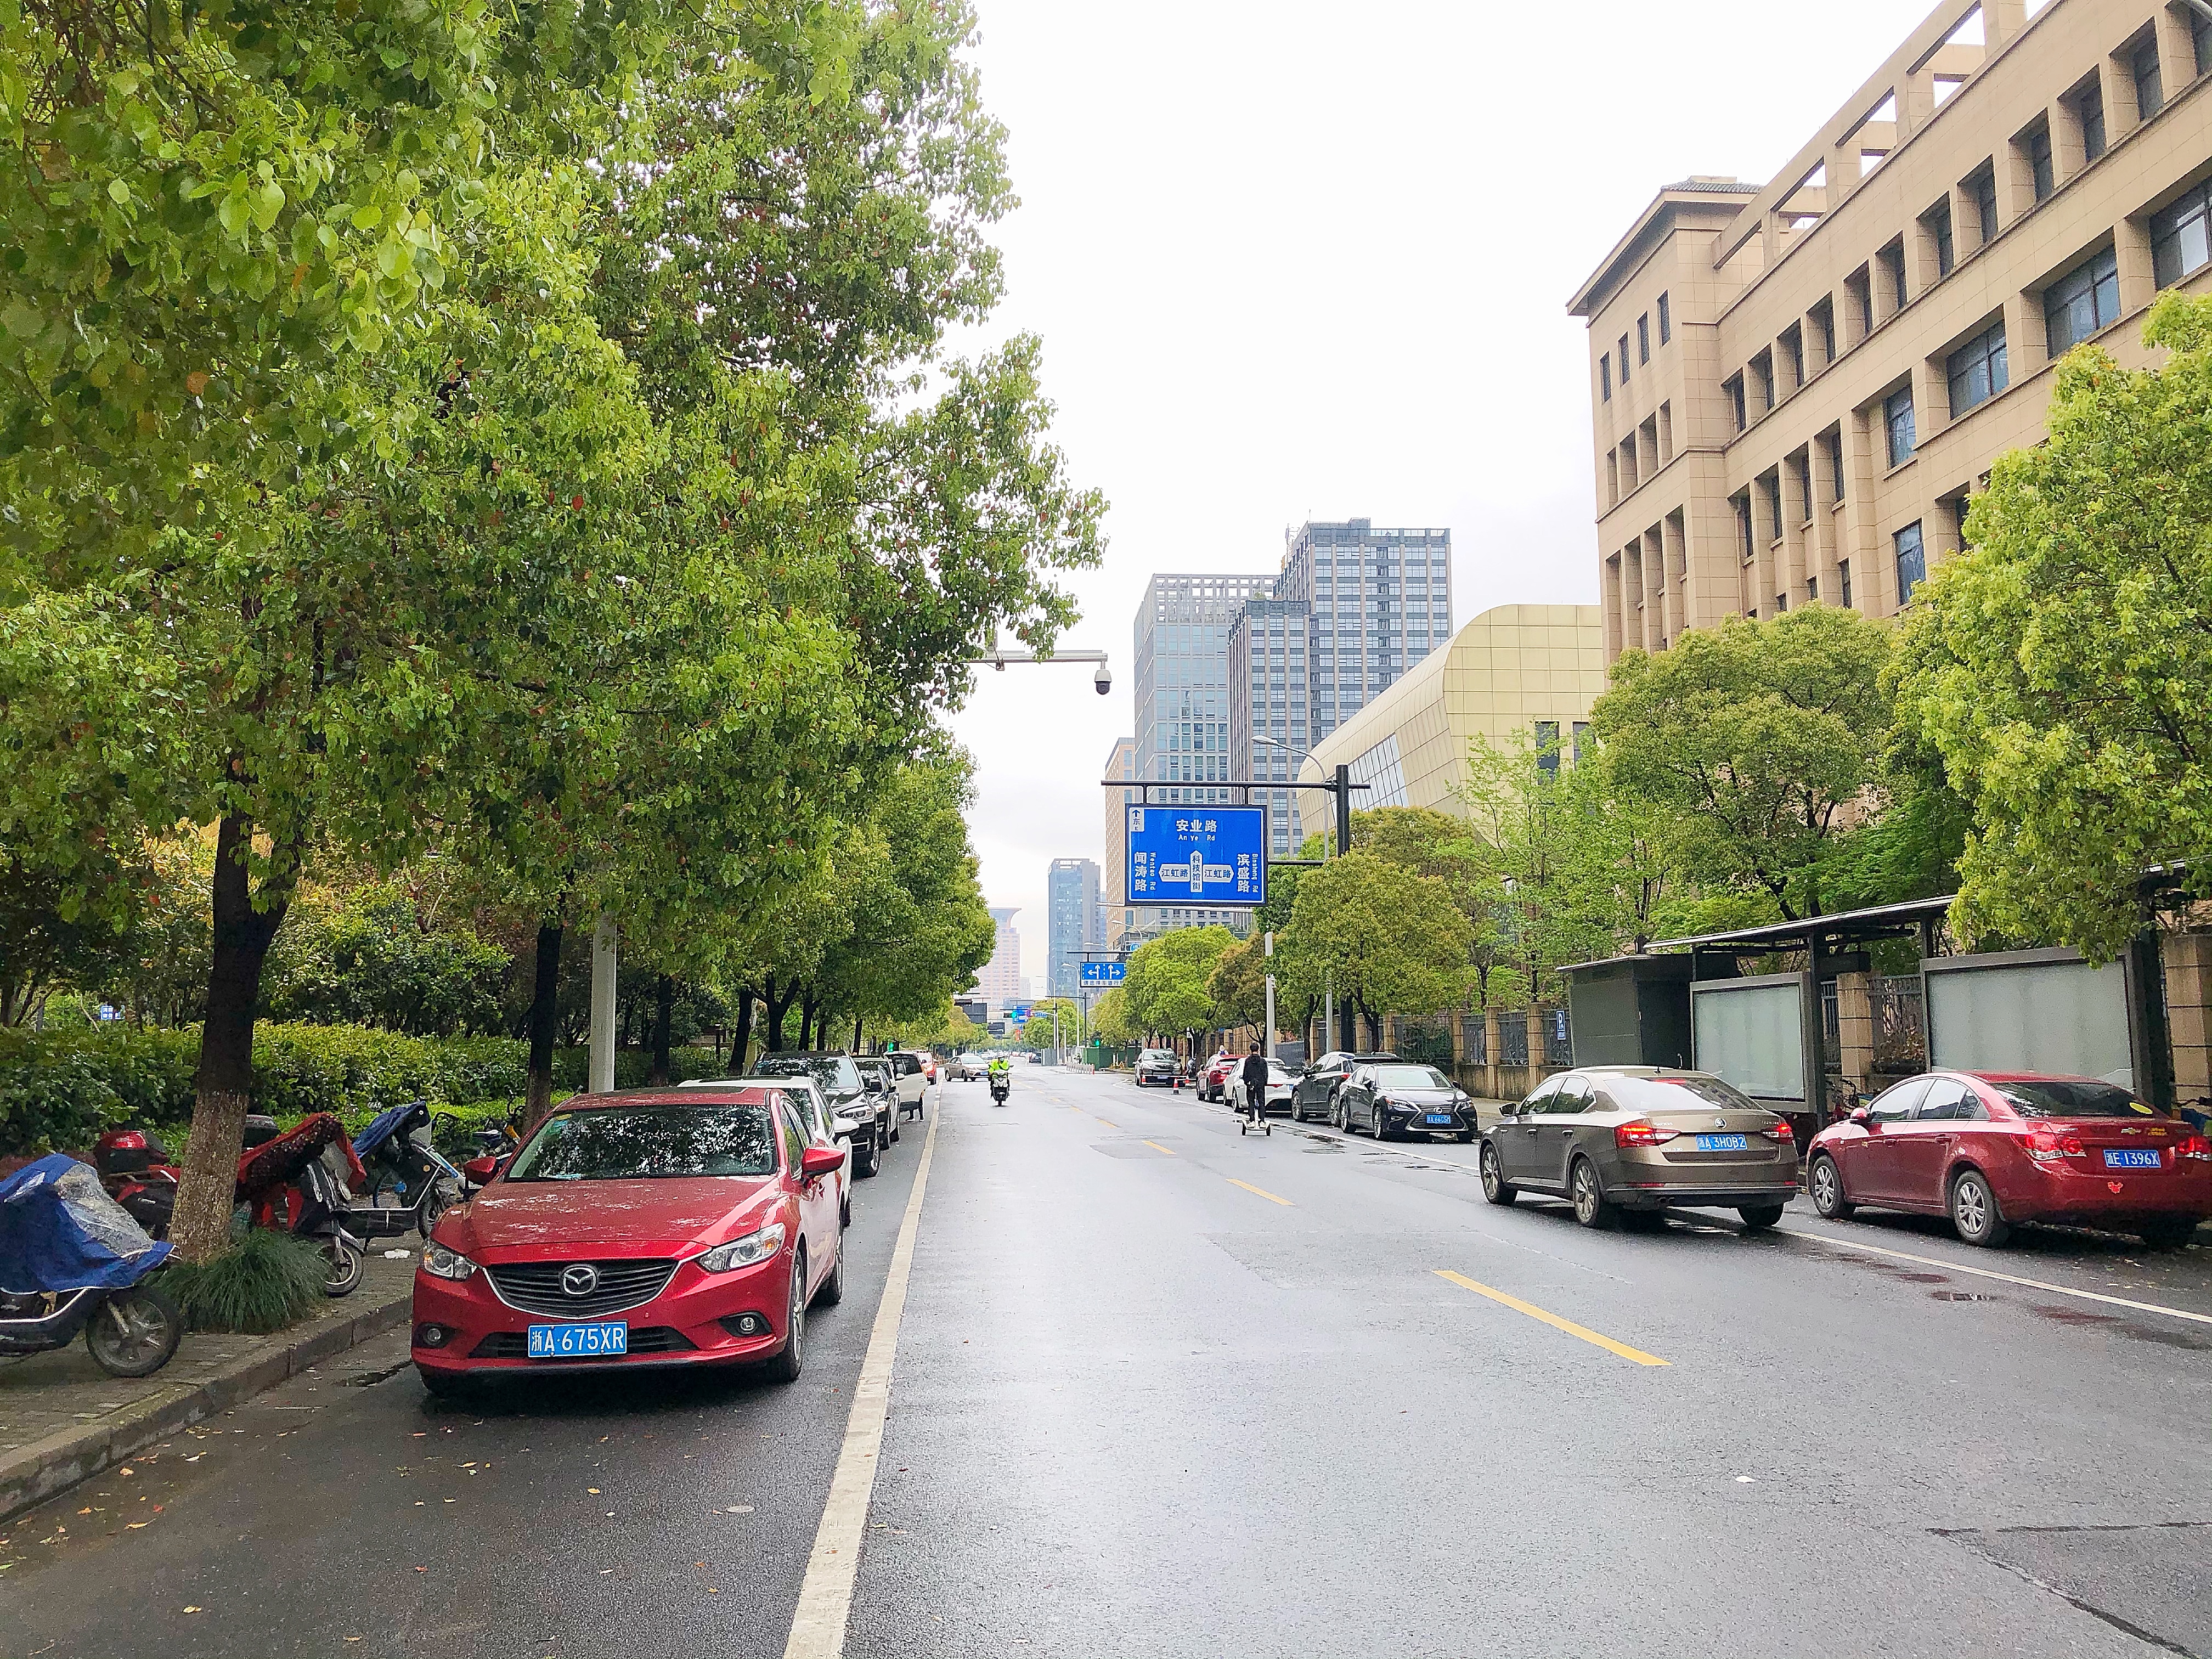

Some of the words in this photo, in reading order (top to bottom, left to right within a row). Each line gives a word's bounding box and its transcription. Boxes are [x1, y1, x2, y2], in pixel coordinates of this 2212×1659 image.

[1176, 819, 1217, 832] 安业路
[1134, 851, 1147, 891] 闻涛路
[1161, 868, 1188, 878] 江虹路
[1192, 855, 1200, 890] 科技馆街
[1204, 868, 1231, 878] 江虹路
[1237, 854, 1250, 893] 滨盛路
[1150, 882, 1156, 890] Rd
[532, 1327, 624, 1352] 浙A·675XR
